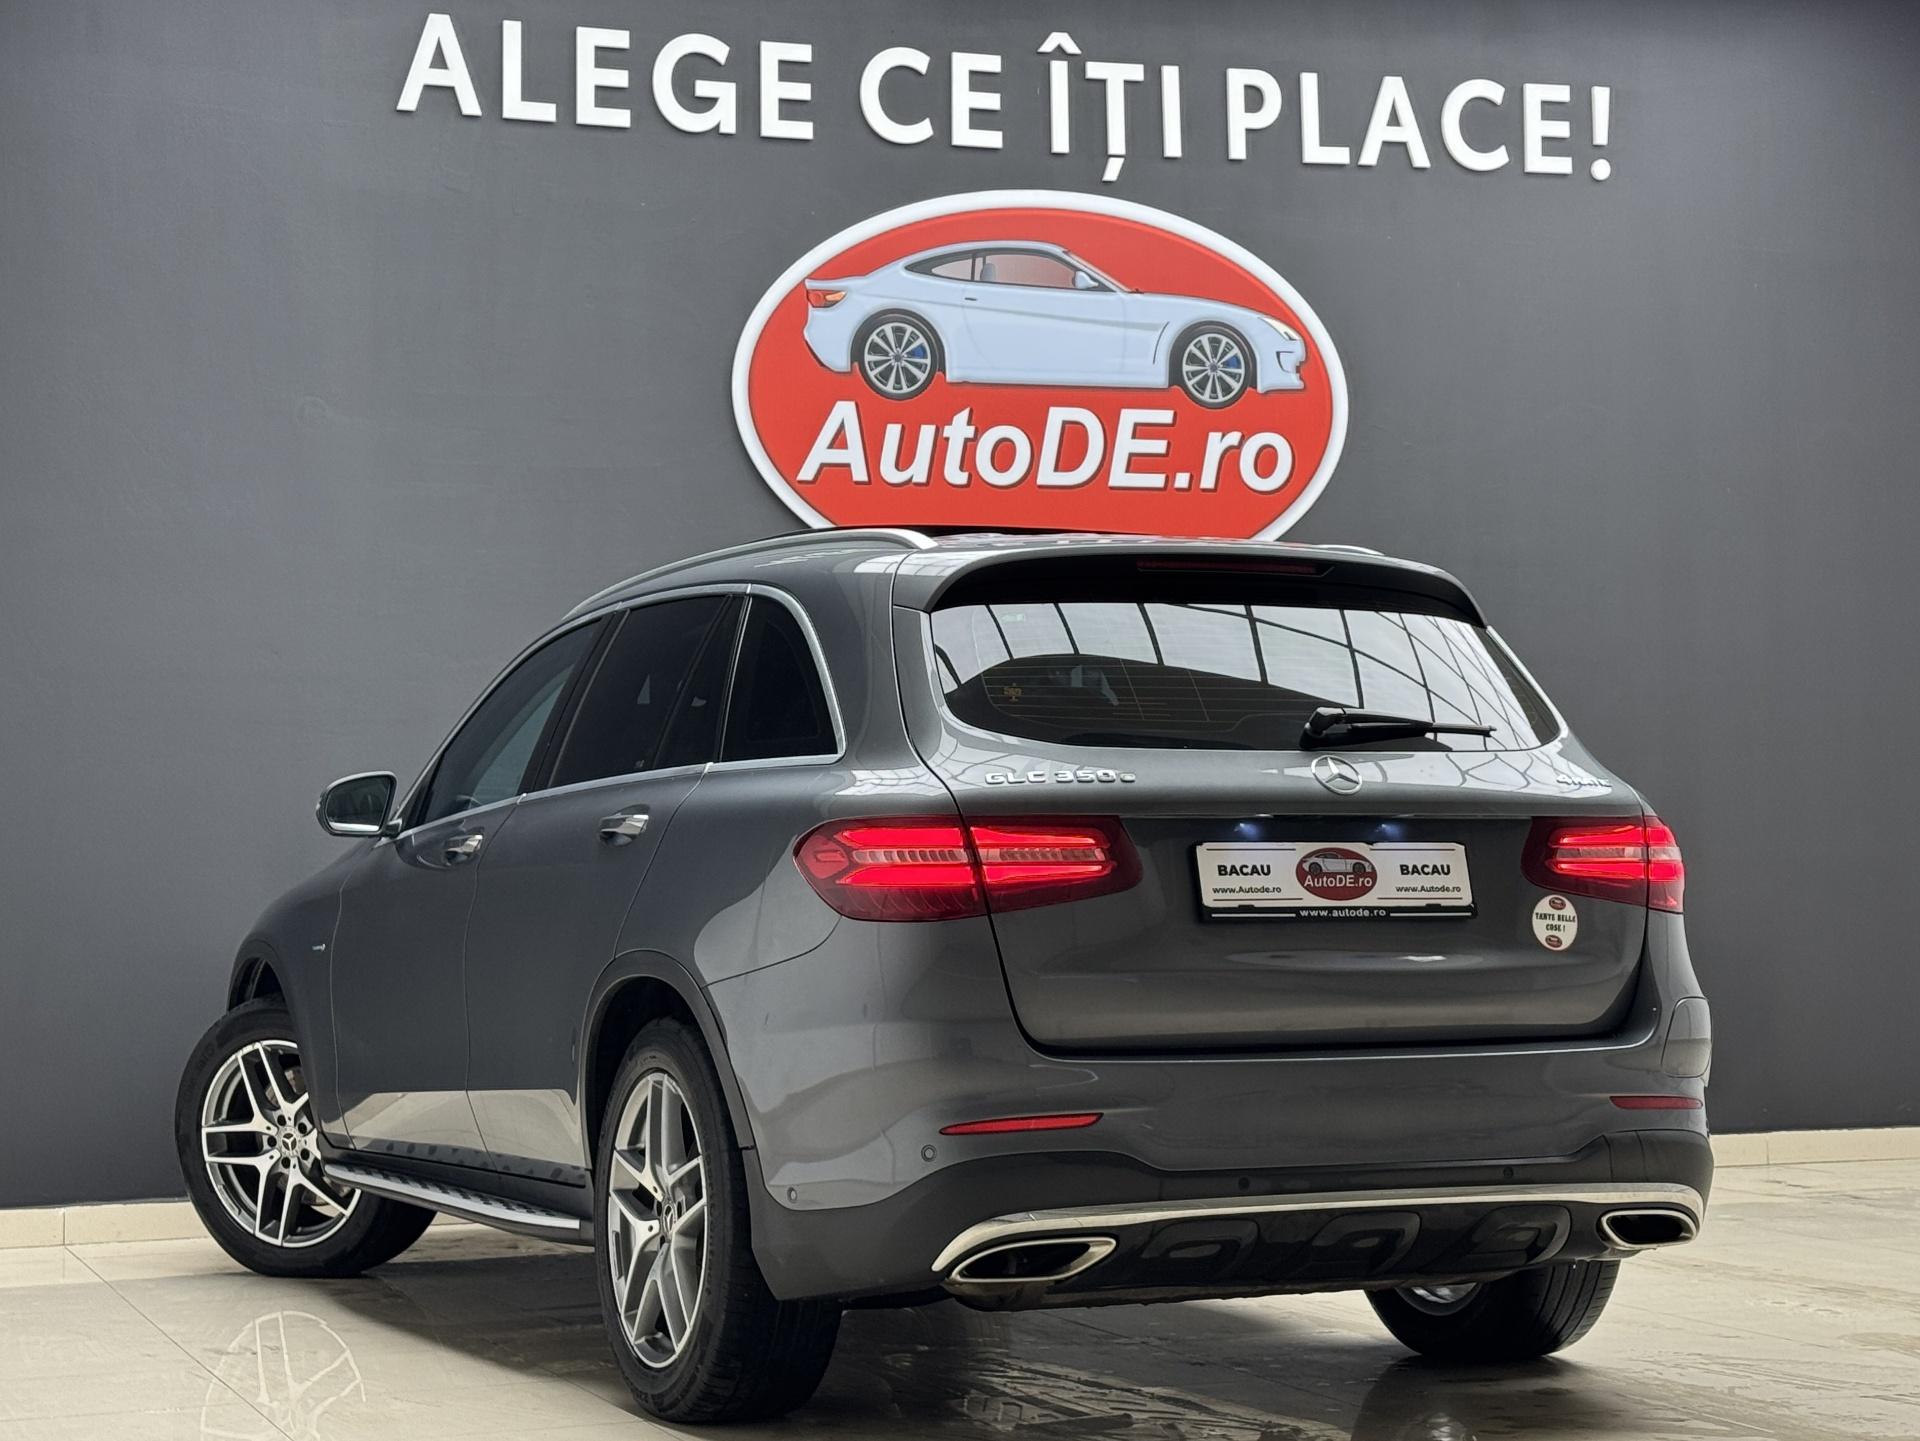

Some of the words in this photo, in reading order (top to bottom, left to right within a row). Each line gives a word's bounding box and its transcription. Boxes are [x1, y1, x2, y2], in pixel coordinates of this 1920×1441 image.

[396, 13, 814, 139] ALEGE
[859, 47, 1003, 148] CE
[1037, 32, 1183, 182] ÎȚI
[1226, 67, 1612, 181] PLACE!
[797, 400, 1294, 493] AutoDE.ro
[985, 770, 1047, 784] GLC
[1217, 864, 1271, 876] BACAU
[1399, 864, 1451, 876] BACAU
[1304, 874, 1373, 888] AutoDE.ro
[1212, 885, 1282, 894] www.Autode.ro
[1395, 885, 1462, 893] www.Autode.ro
[1300, 908, 1387, 917] www.autode.ro
[1535, 912, 1556, 921] TANTE
